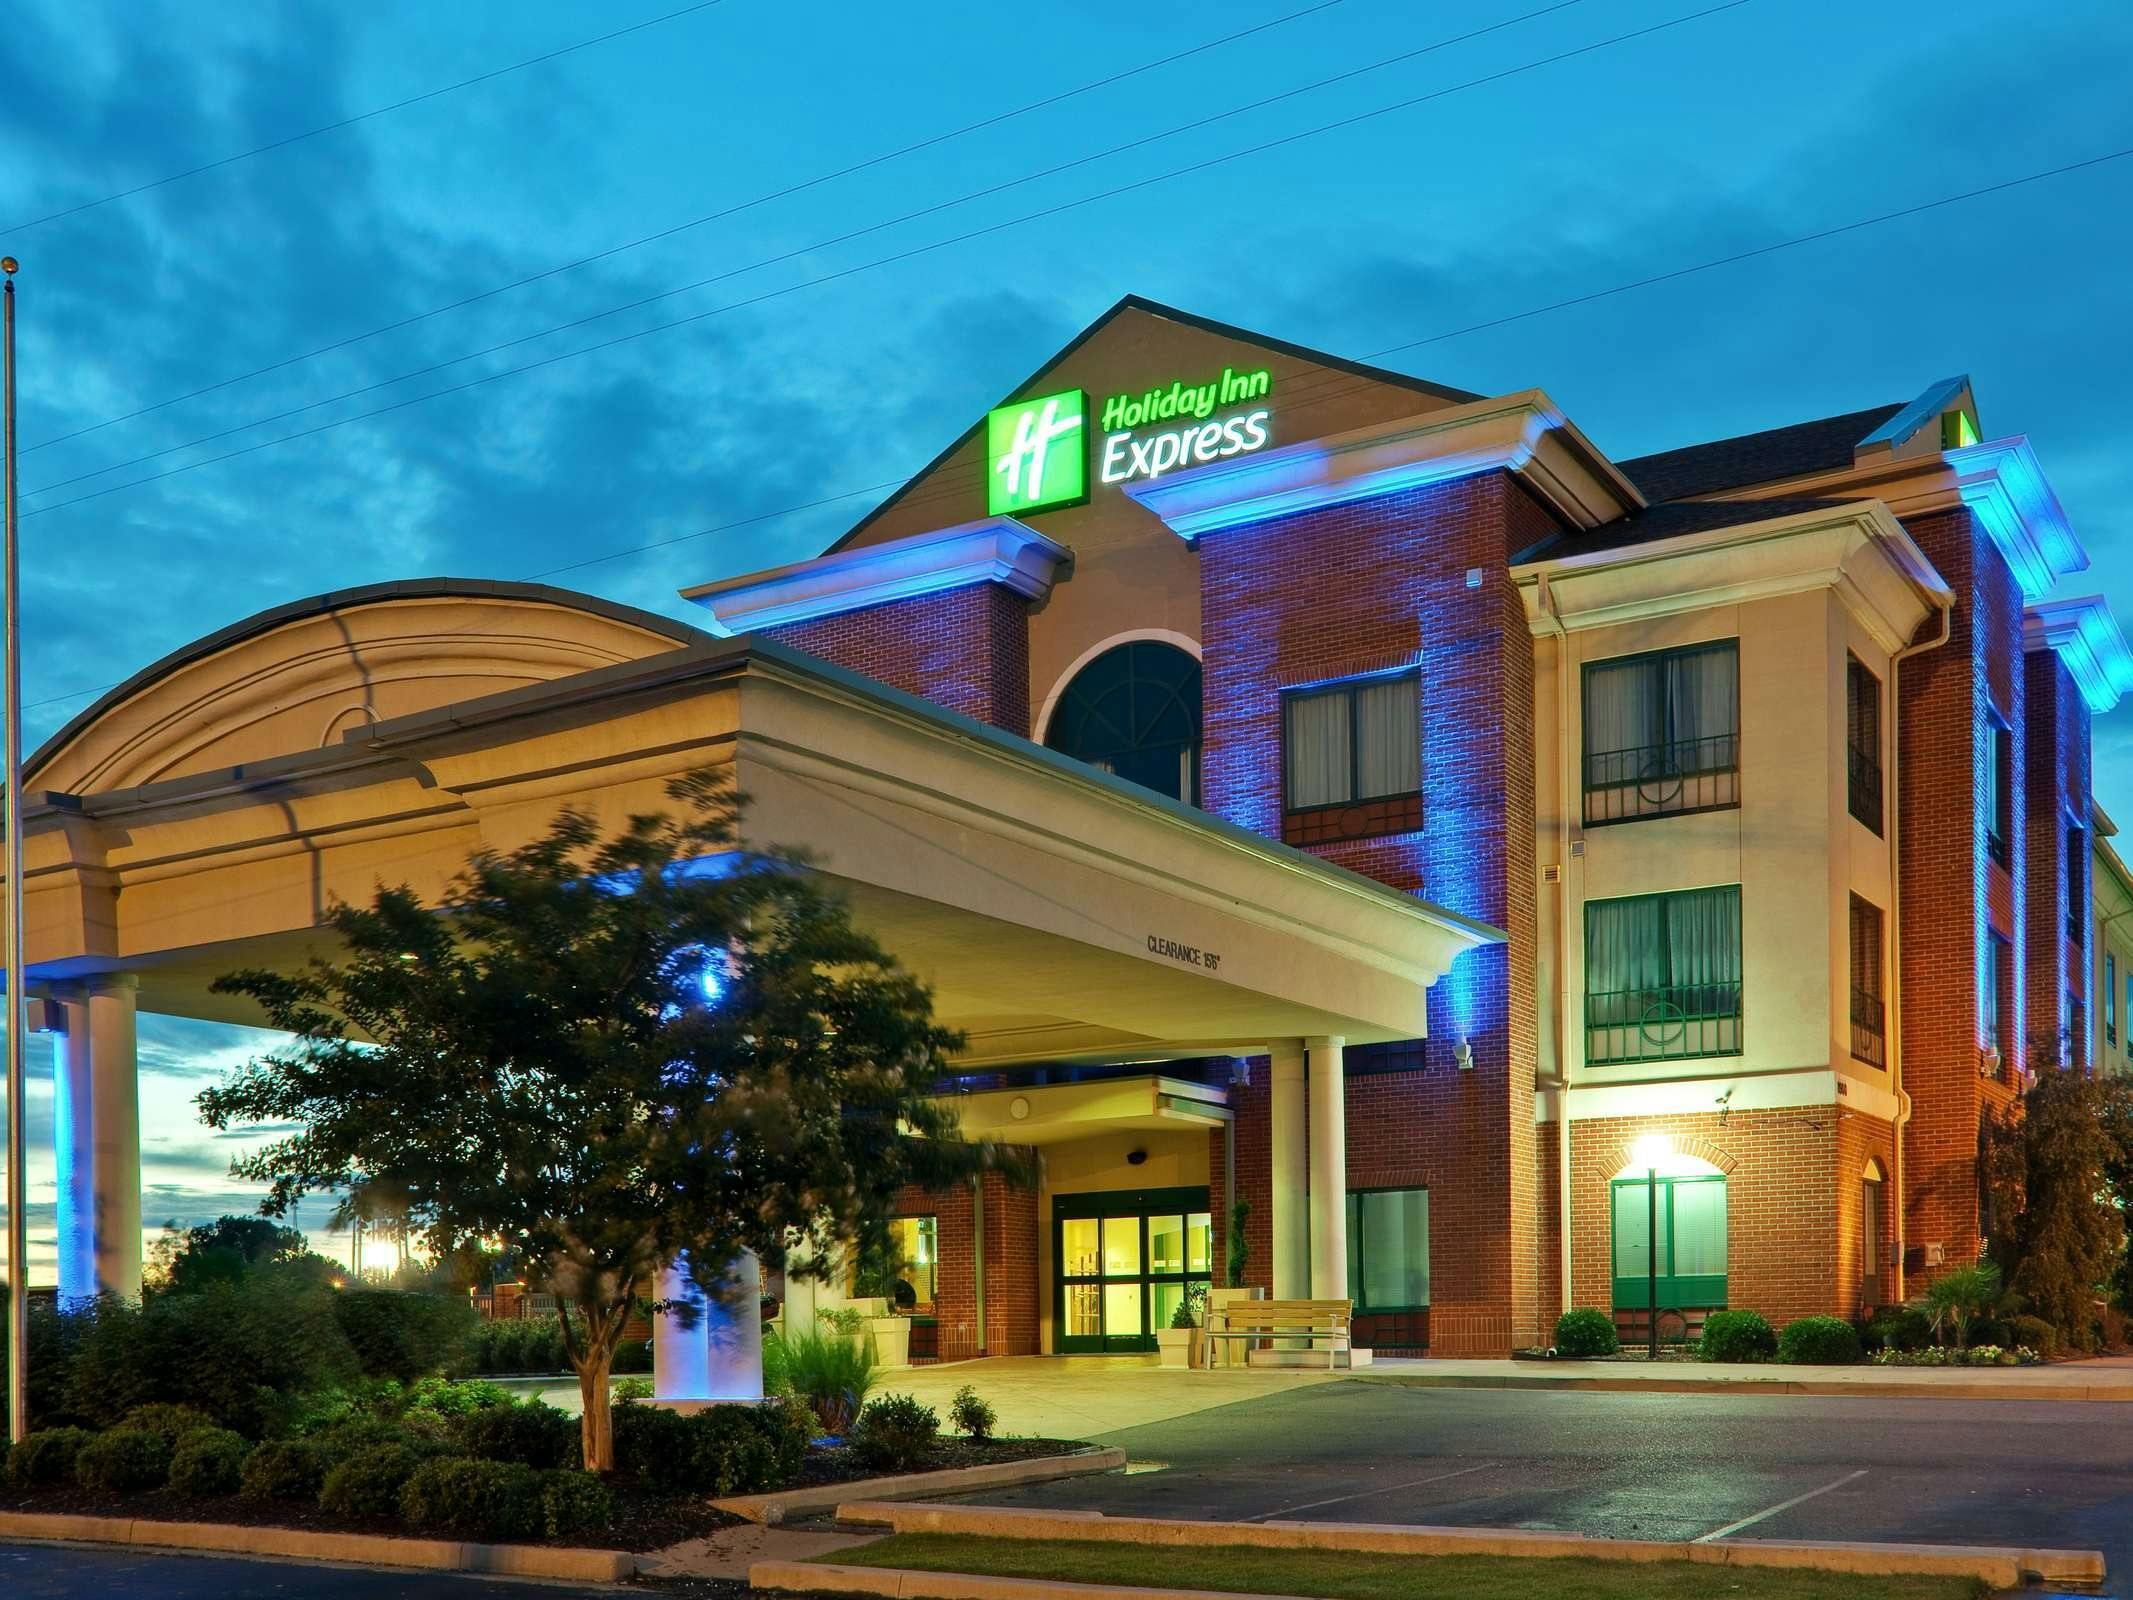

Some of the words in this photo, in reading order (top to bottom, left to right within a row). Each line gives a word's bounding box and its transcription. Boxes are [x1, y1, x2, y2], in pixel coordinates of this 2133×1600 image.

[1102, 382, 1217, 432] Holiday
[1220, 368, 1269, 404] Inn
[1101, 411, 1269, 483] Express
[1147, 935, 1202, 966] CLEARANCE
